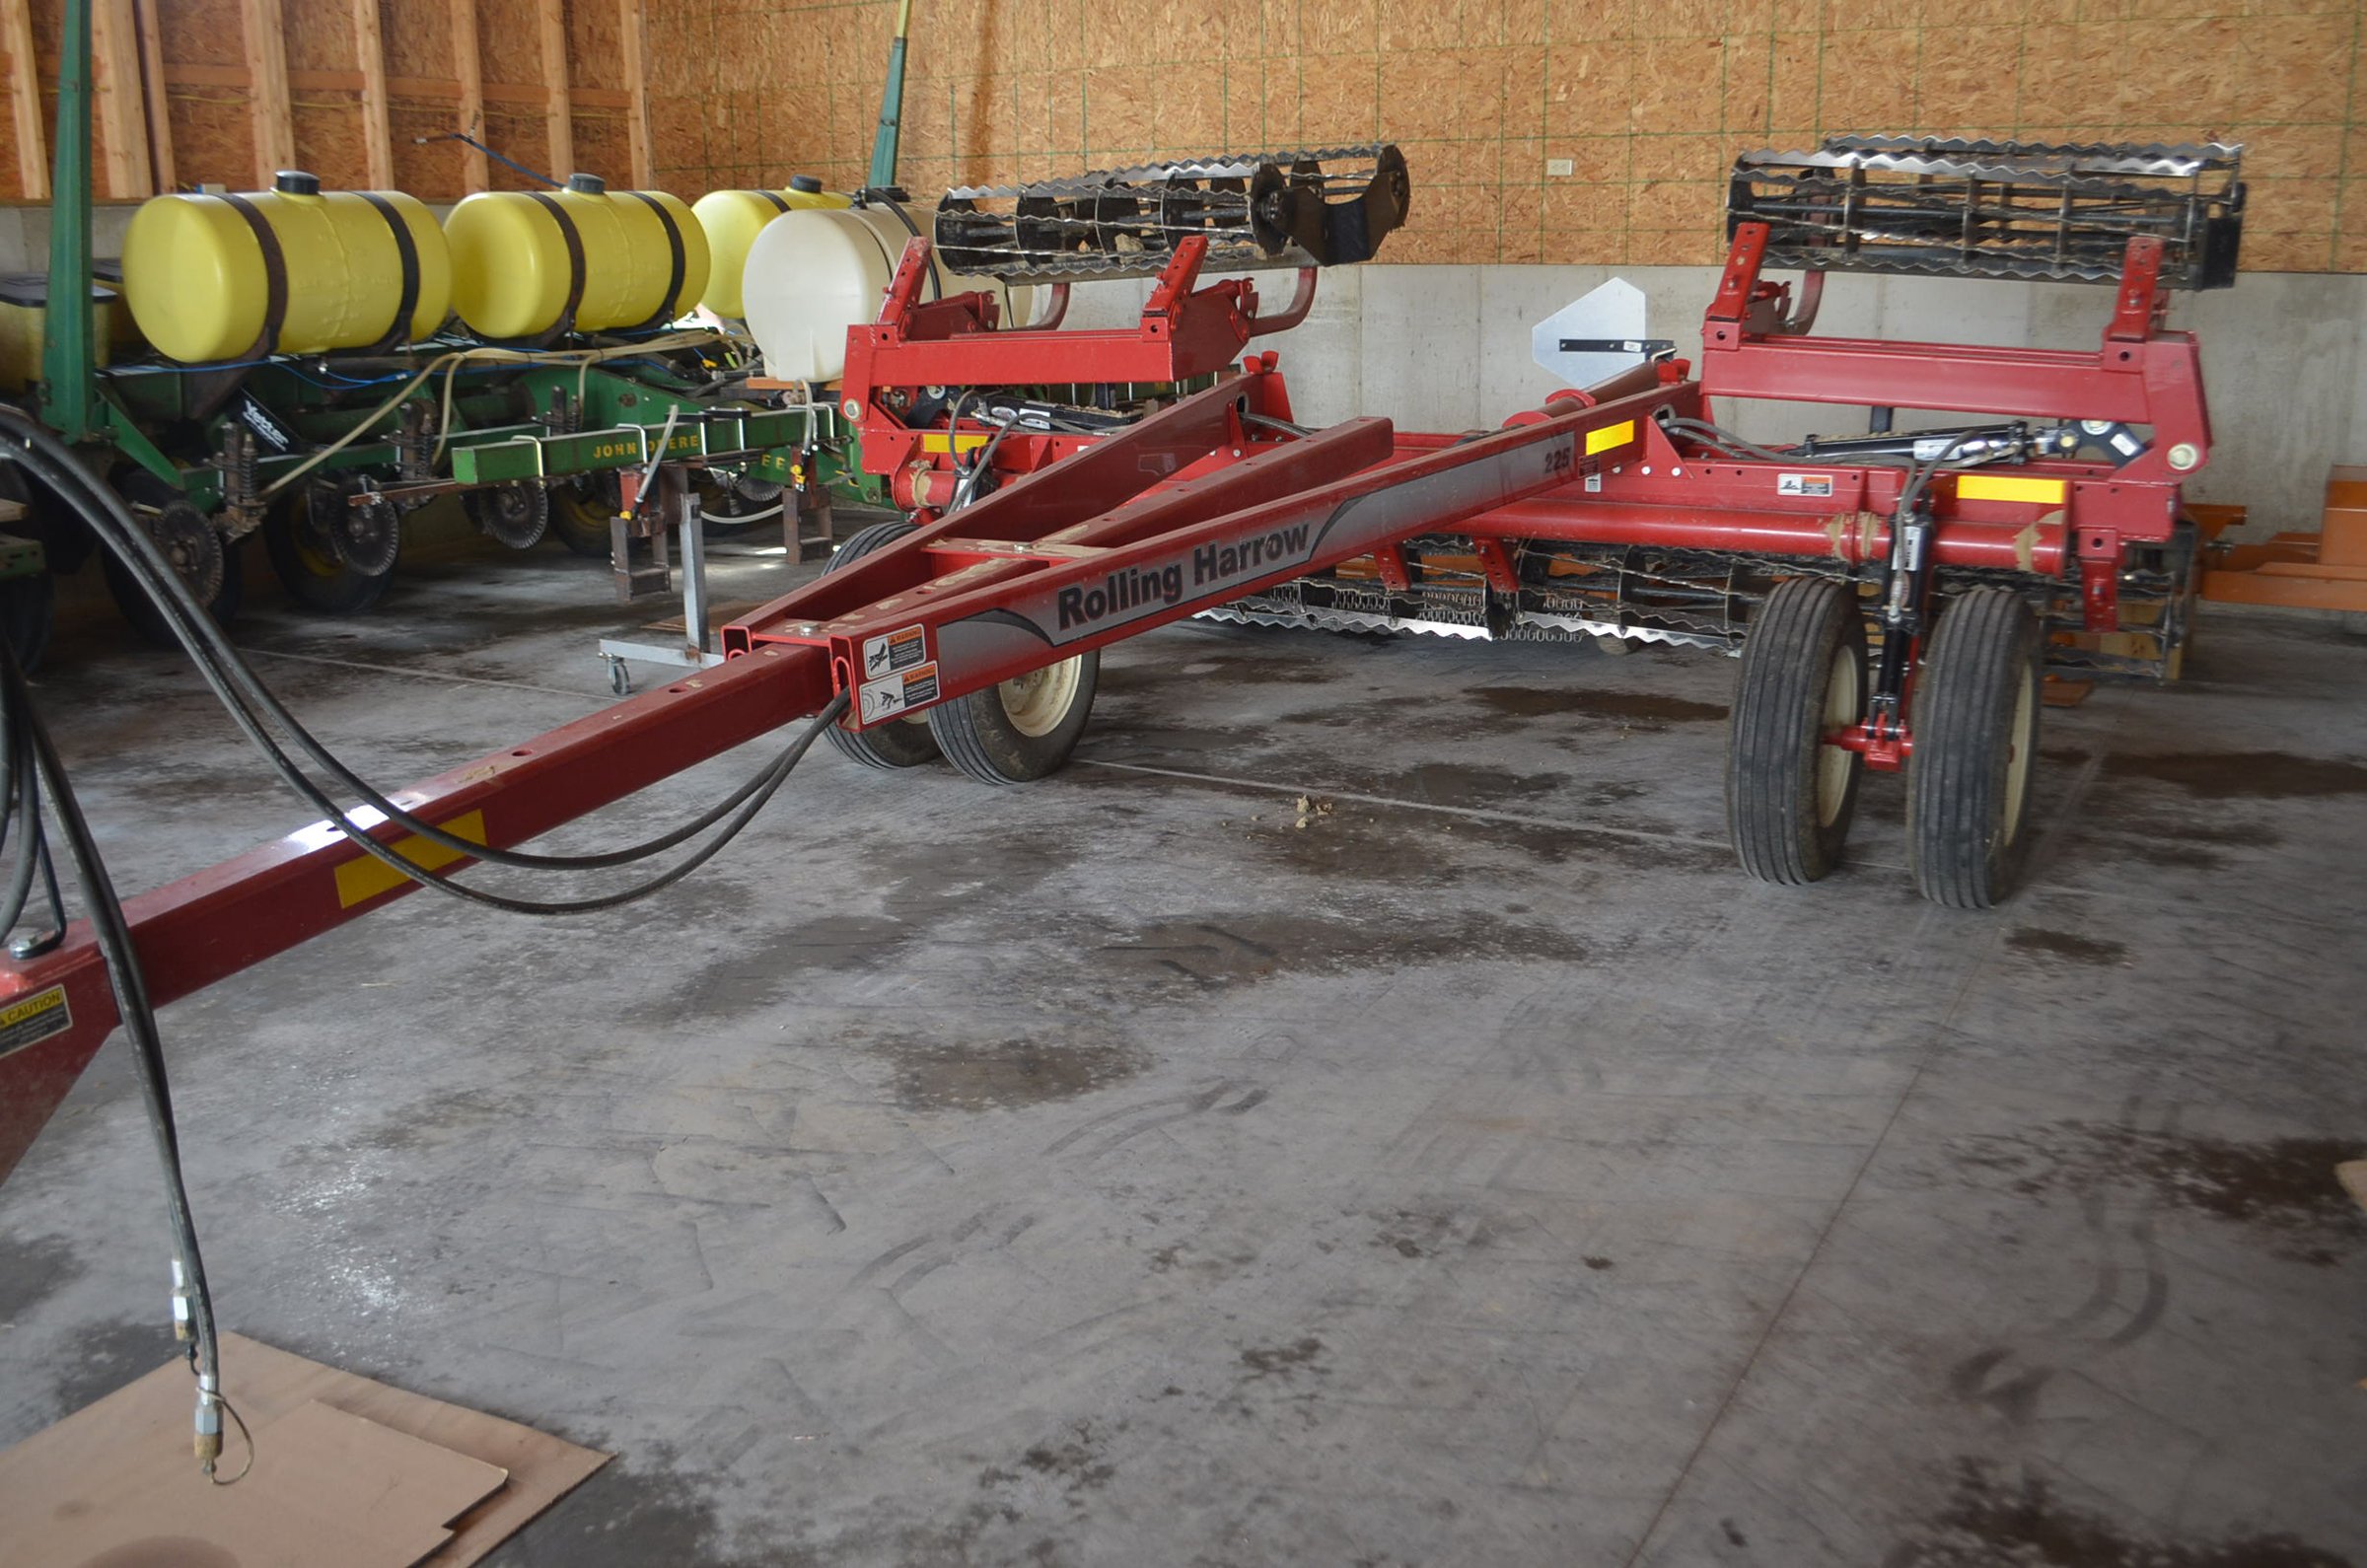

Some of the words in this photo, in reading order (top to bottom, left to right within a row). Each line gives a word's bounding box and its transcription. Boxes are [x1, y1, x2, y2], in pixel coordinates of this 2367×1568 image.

[594, 442, 637, 459] JOHN
[647, 435, 699, 452] DERE
[1544, 446, 1571, 474] 225
[1058, 562, 1183, 632] Rolling
[1193, 523, 1310, 587] Harrow
[8, 990, 61, 1022] CAUTION
